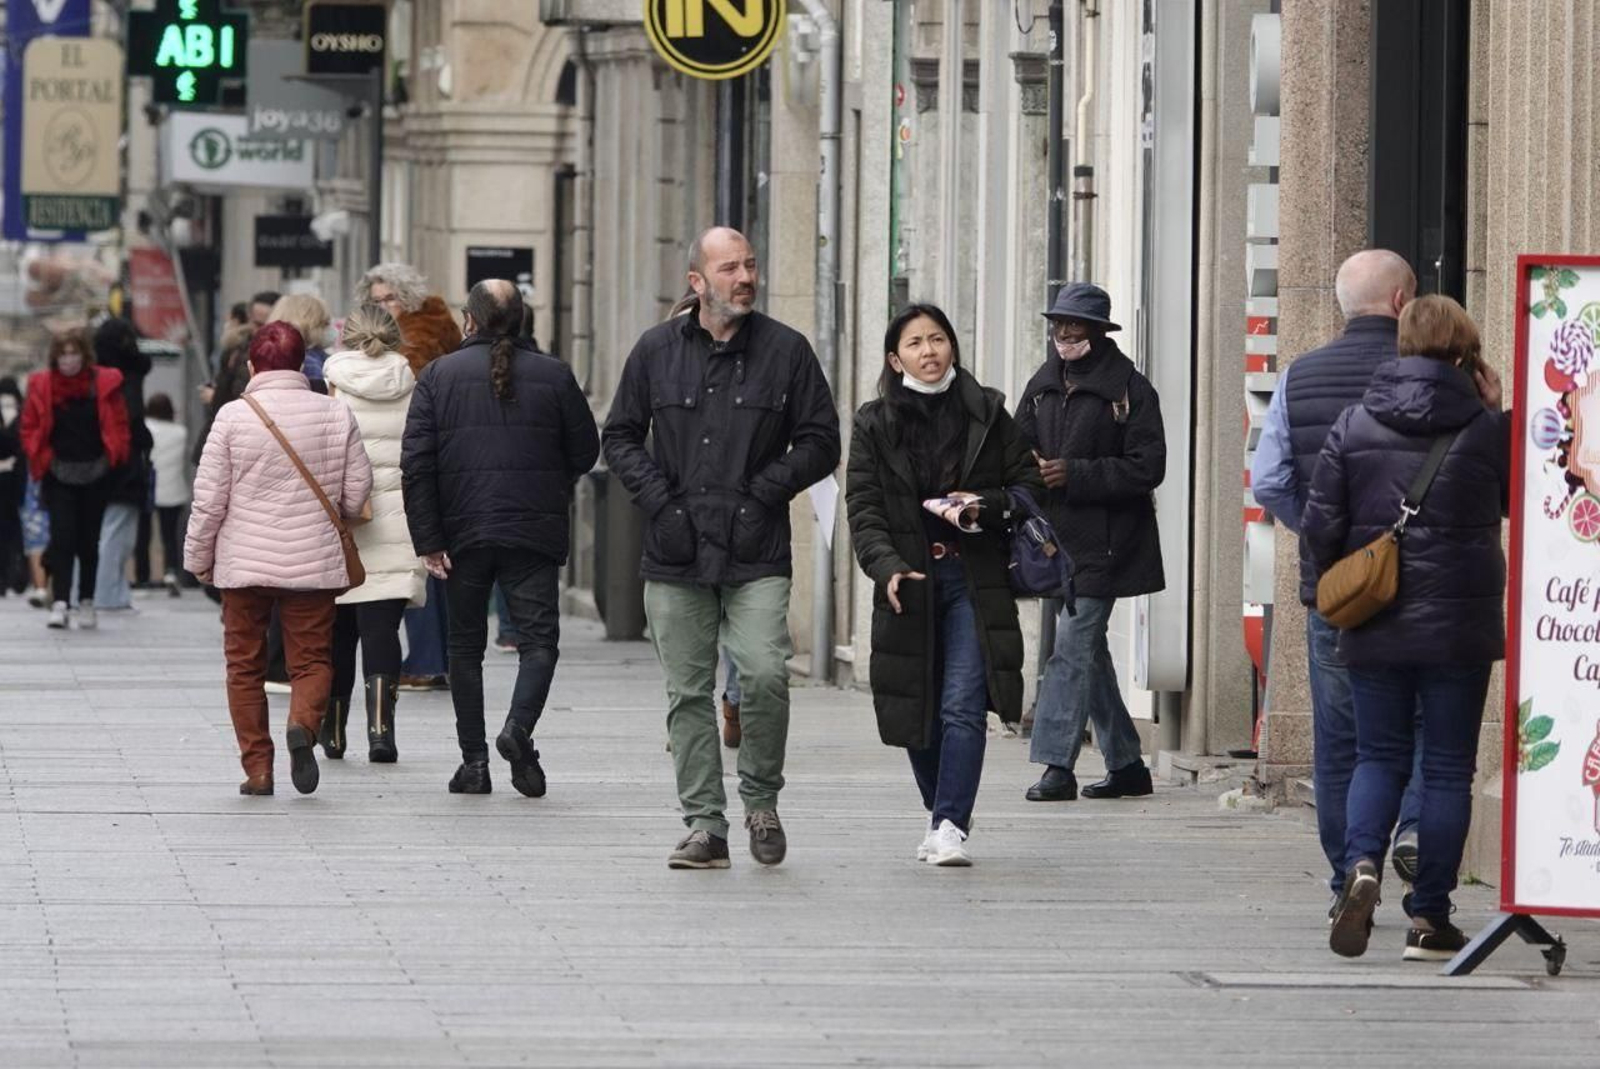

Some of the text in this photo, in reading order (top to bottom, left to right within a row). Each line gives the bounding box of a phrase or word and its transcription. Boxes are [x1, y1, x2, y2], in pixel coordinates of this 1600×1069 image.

[311, 33, 383, 52] OYSHO
[61, 44, 88, 68] EL
[30, 78, 114, 103] PORTAL
[238, 139, 304, 161] world
[1546, 576, 1591, 612] Café
